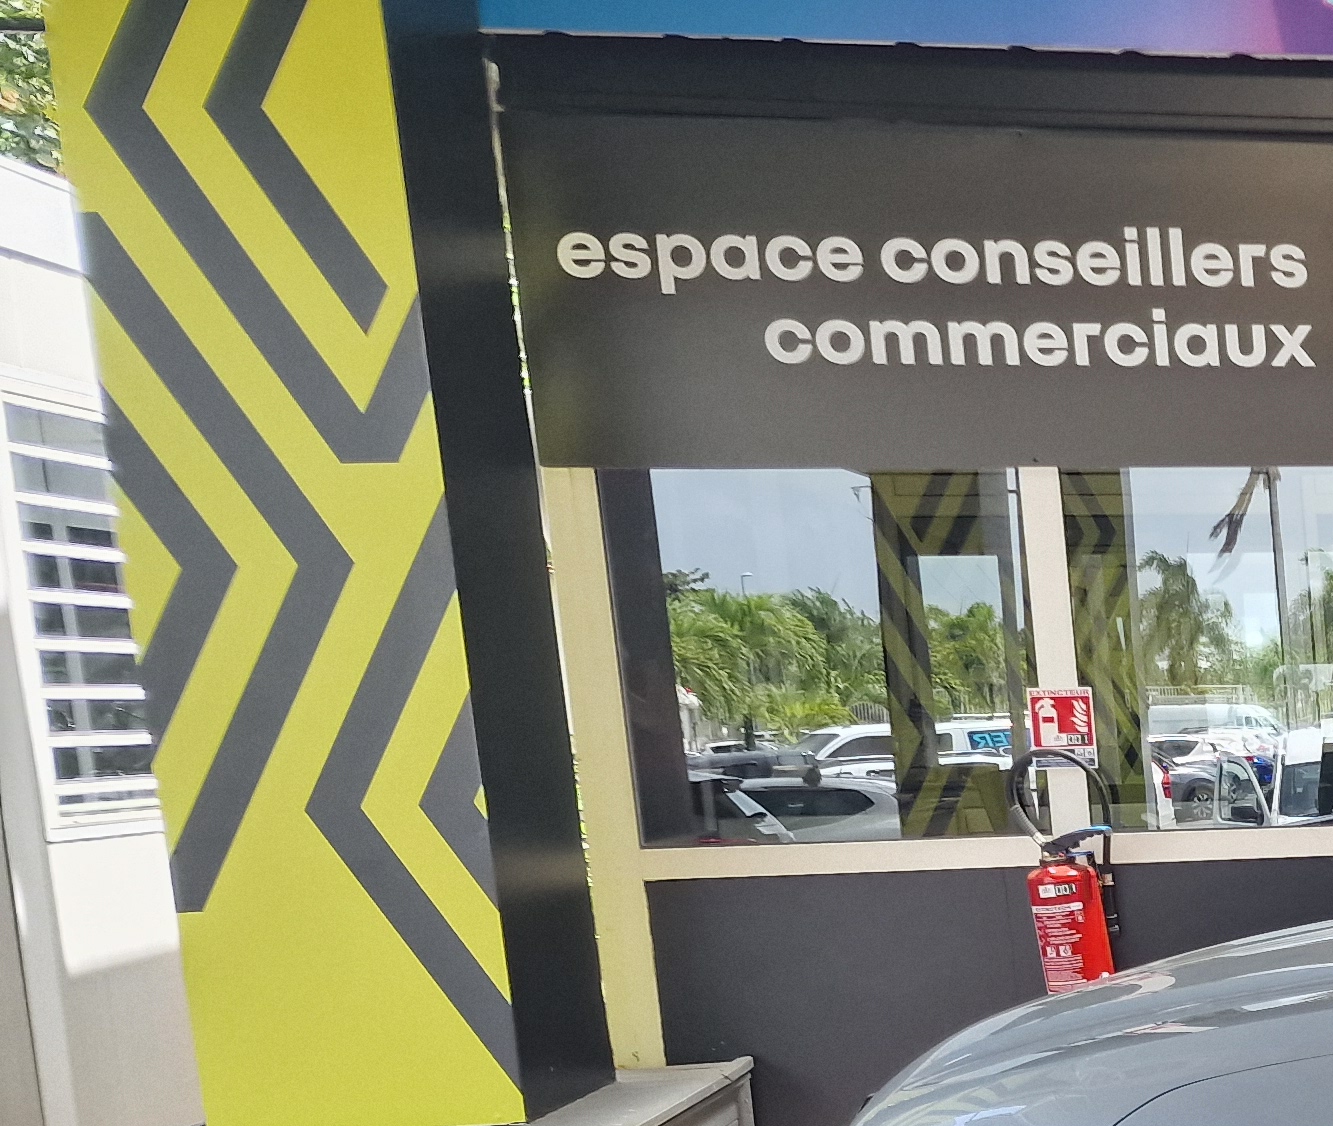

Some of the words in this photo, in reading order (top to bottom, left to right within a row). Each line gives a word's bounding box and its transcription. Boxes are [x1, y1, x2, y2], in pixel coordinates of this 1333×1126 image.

[556, 231, 864, 294] espace
[880, 226, 1308, 288] conseillers
[764, 308, 1316, 368] commerciaux
[1029, 689, 1089, 697] EXTINCTEUR
